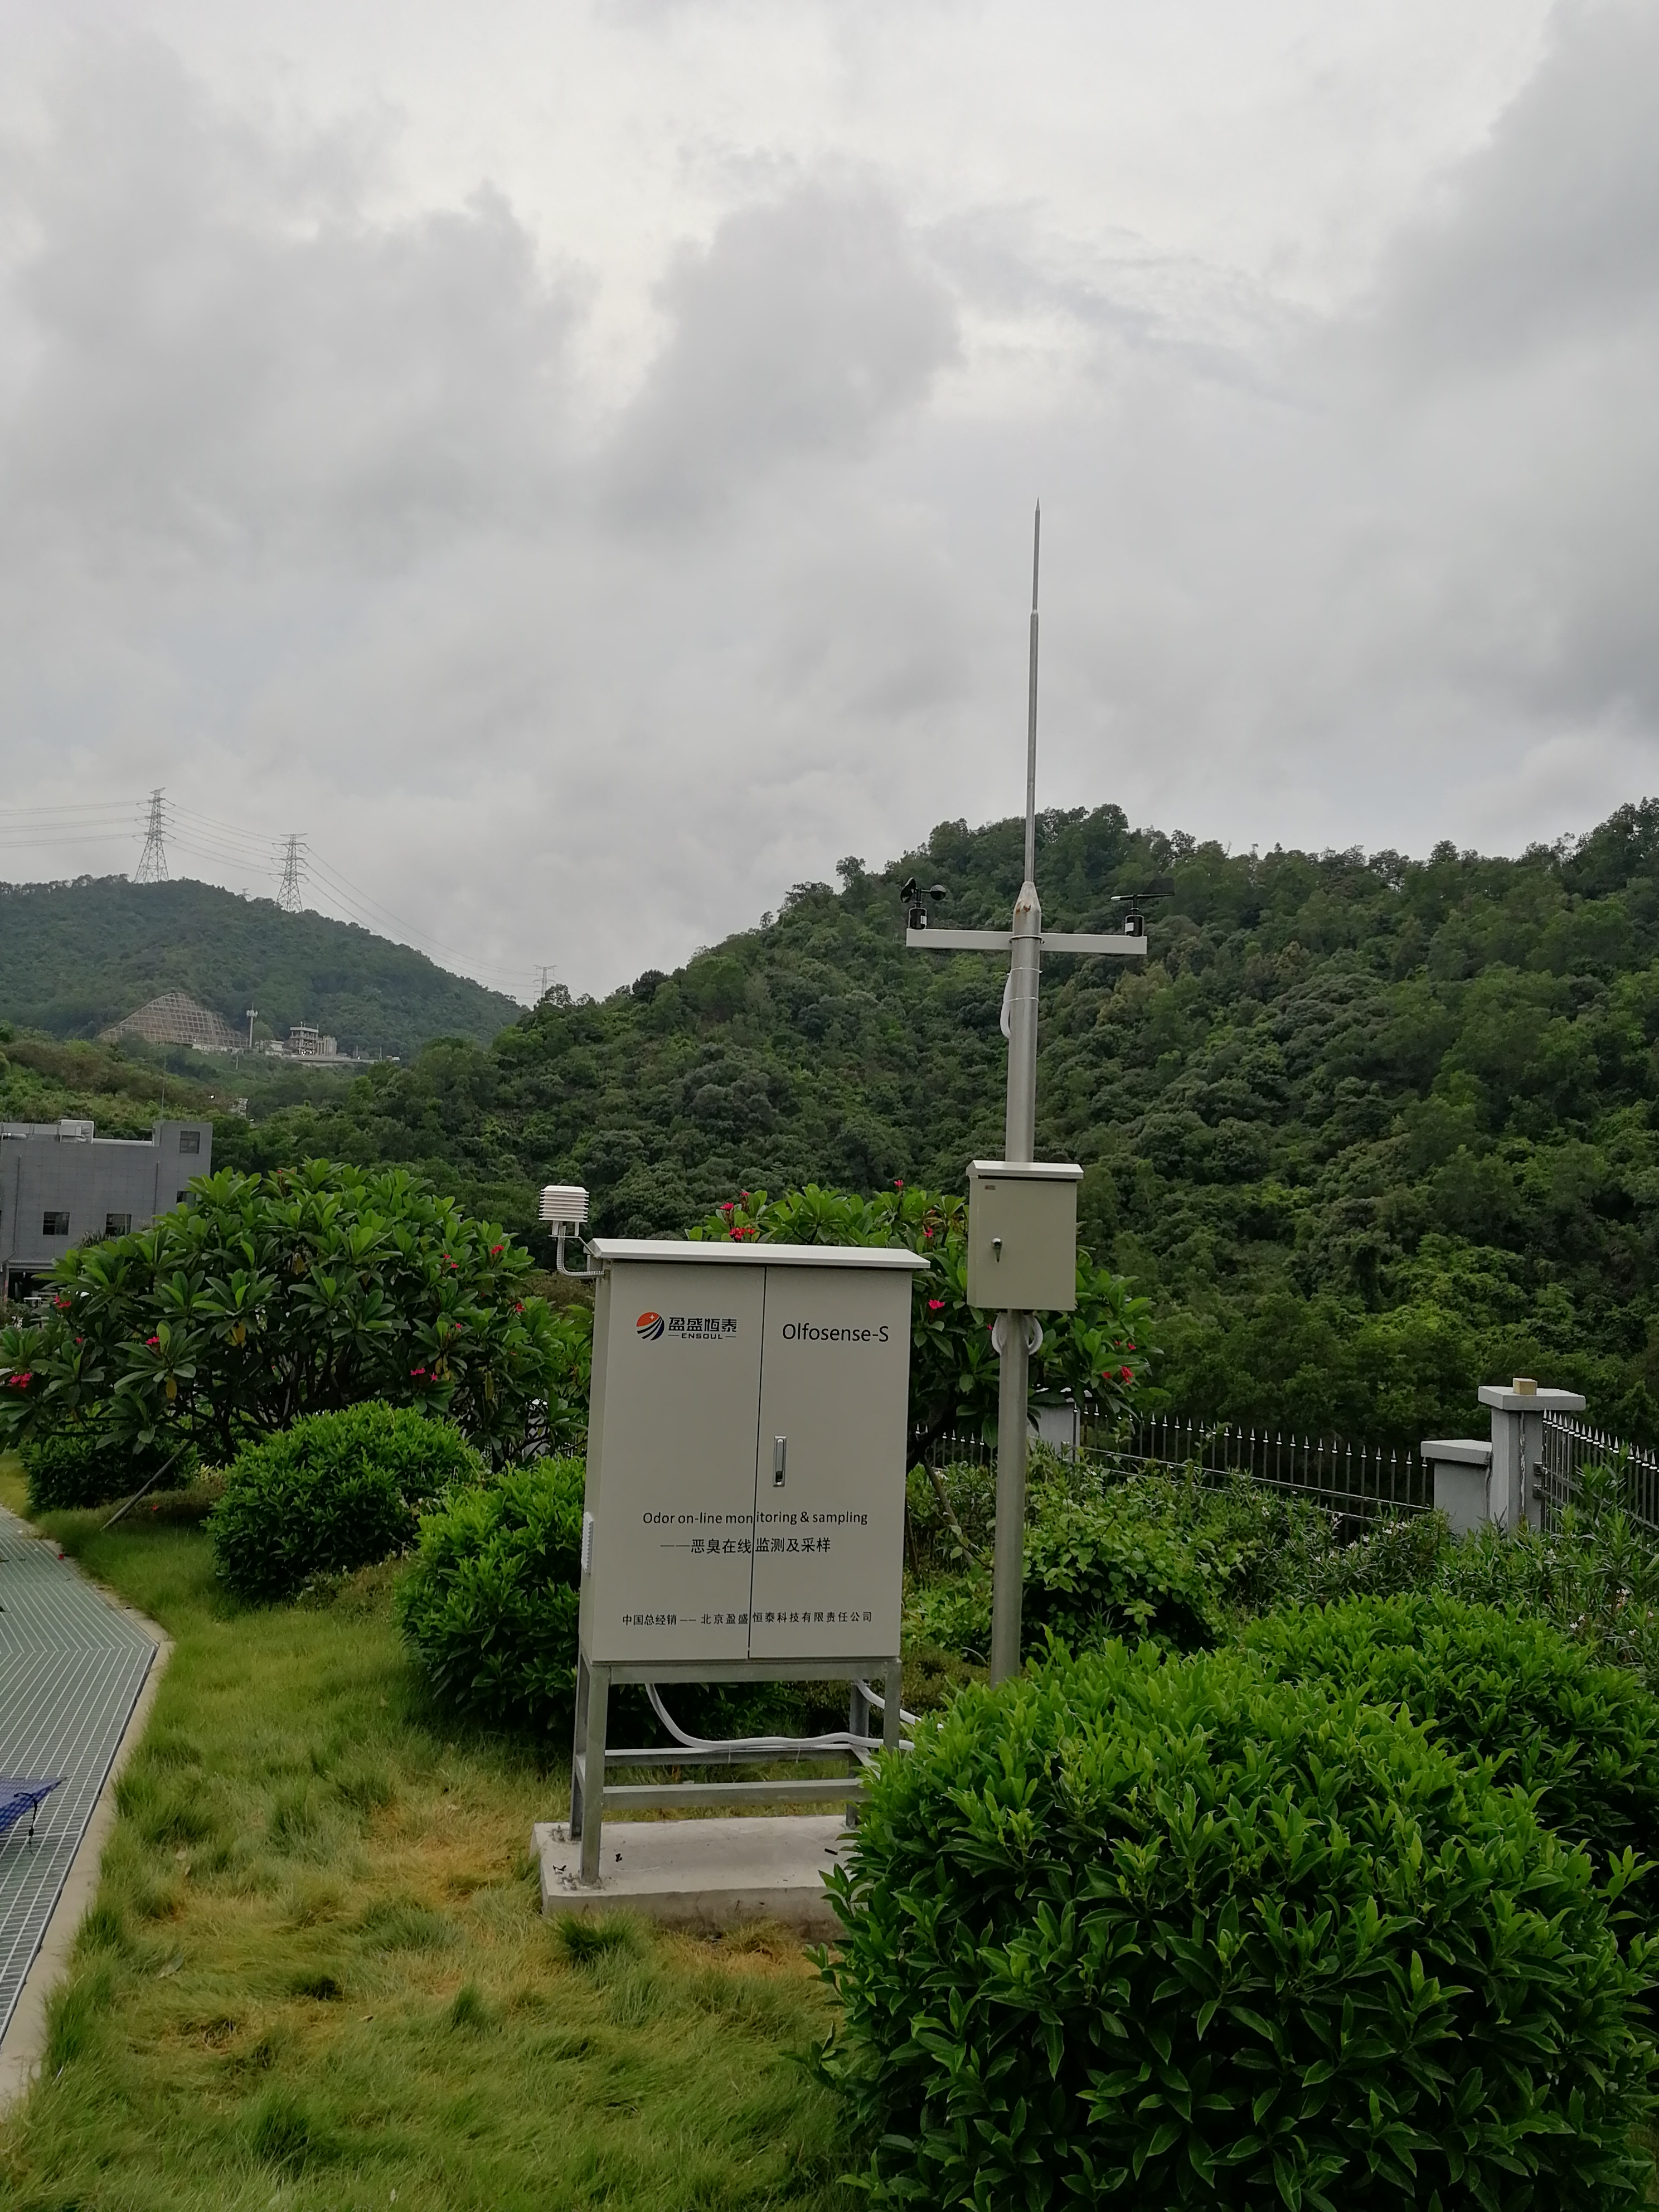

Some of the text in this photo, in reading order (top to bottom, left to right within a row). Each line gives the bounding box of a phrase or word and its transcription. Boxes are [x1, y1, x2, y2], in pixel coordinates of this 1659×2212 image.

[783, 1322, 889, 1342] Olfosense-S
[643, 1511, 867, 1525] Odor on-line monitoring & sampling
